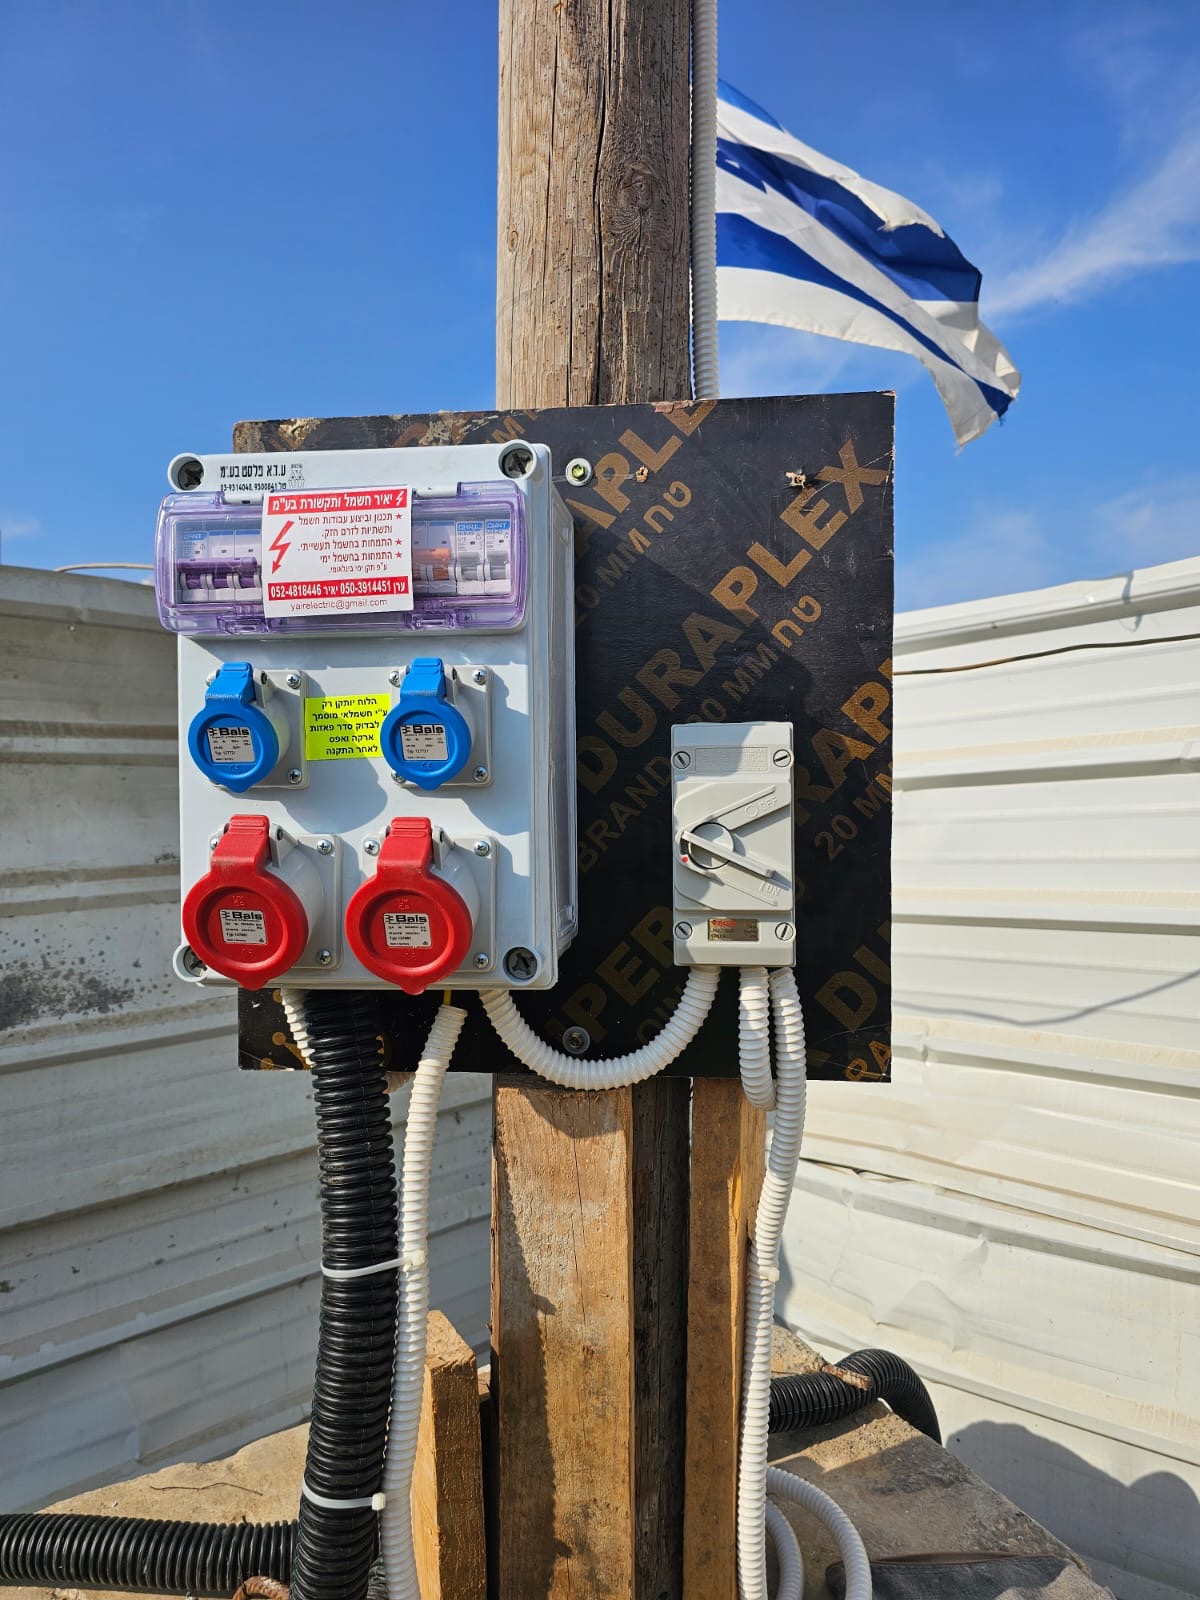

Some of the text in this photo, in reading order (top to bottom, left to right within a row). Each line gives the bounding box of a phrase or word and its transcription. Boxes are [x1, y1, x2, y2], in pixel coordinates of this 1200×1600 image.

[242, 464, 264, 478] פלסט
[272, 492, 392, 511] יאיר חשמל ותקשורת בע"מ
[298, 512, 392, 526] תכנון וביצוע עבודות חשמל
[322, 525, 392, 538] ותשתיות לזרם חזק.
[333, 539, 359, 549] בחשמל
[362, 538, 392, 548] התמחות
[333, 553, 359, 562] בחשמל
[362, 551, 392, 561] התמחות
[596, 527, 651, 588] MM
[270, 580, 405, 598] ערן 050-3914451 יאיר 052-4818446
[290, 598, 388, 611] yairelectric@gmail.com
[576, 439, 890, 796] DURAPLEX
[322, 697, 377, 710] הלוח יותקן רק
[312, 713, 338, 721] מוסמך
[340, 710, 372, 718] חשמלאי
[219, 727, 250, 735] Bals
[310, 724, 334, 732] פאזות
[356, 720, 379, 731] לבדוק
[413, 724, 444, 733] Bals
[329, 734, 374, 743] ארקה ואפס
[326, 745, 378, 756] לאחר התקנה
[577, 756, 671, 873] BRAND
[722, 643, 779, 702] MM
[814, 815, 859, 861] 20
[232, 912, 262, 920] Bals
